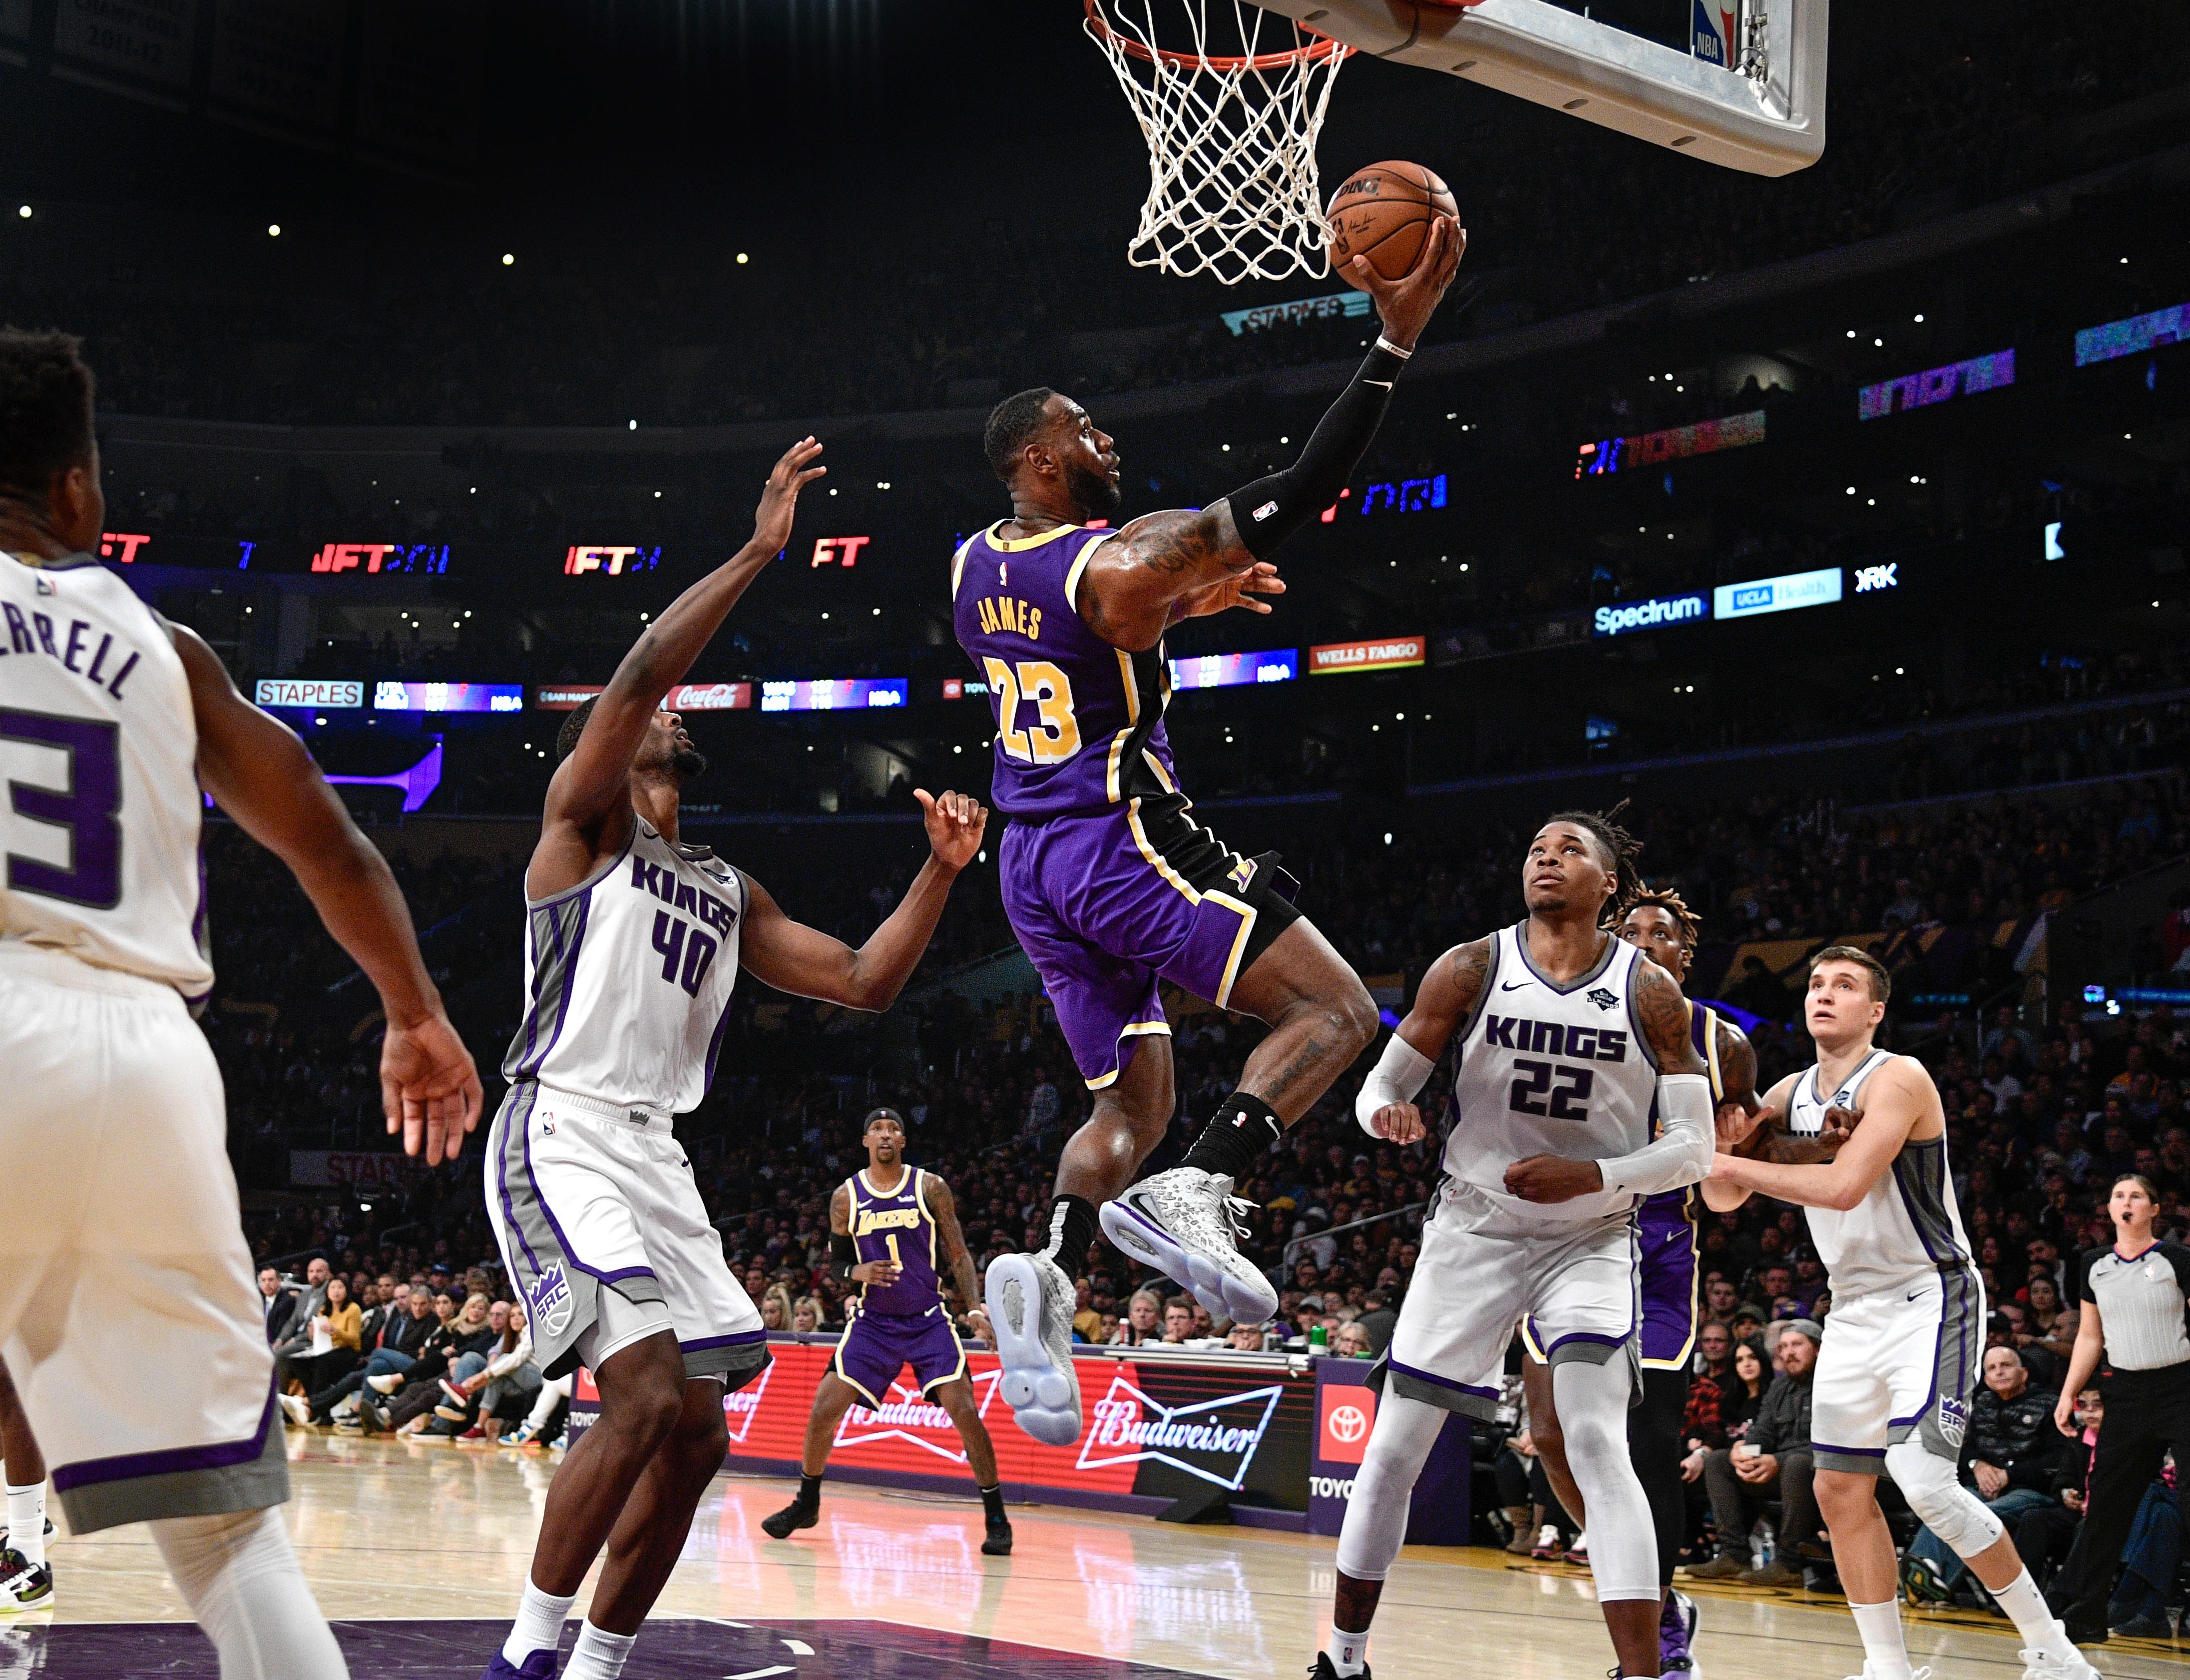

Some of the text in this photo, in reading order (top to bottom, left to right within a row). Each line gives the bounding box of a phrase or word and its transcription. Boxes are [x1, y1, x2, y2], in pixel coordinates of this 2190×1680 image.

[86, 24, 163, 65] 2011-12
[1697, 31, 1719, 60] NBA
[1737, 581, 1827, 608] UCLA Health
[977, 596, 1042, 640] JAMES
[1595, 596, 1702, 636] Spectrum
[0, 601, 140, 700] RRELL
[1316, 643, 1418, 665] WELLS FARGO
[259, 682, 359, 705] STAPLES
[981, 655, 1082, 764] 23
[0, 706, 124, 911] 3
[631, 854, 737, 944] KINGS
[651, 908, 717, 998] 40
[1588, 998, 1619, 1008] ALMONDS
[1486, 1014, 1627, 1062] KINGS
[1510, 1058, 1594, 1121] 22
[856, 1208, 920, 1237] LAKERS
[885, 1234, 904, 1270] 1
[536, 1281, 569, 1322] SAC
[1094, 1399, 1256, 1454] Budweiser
